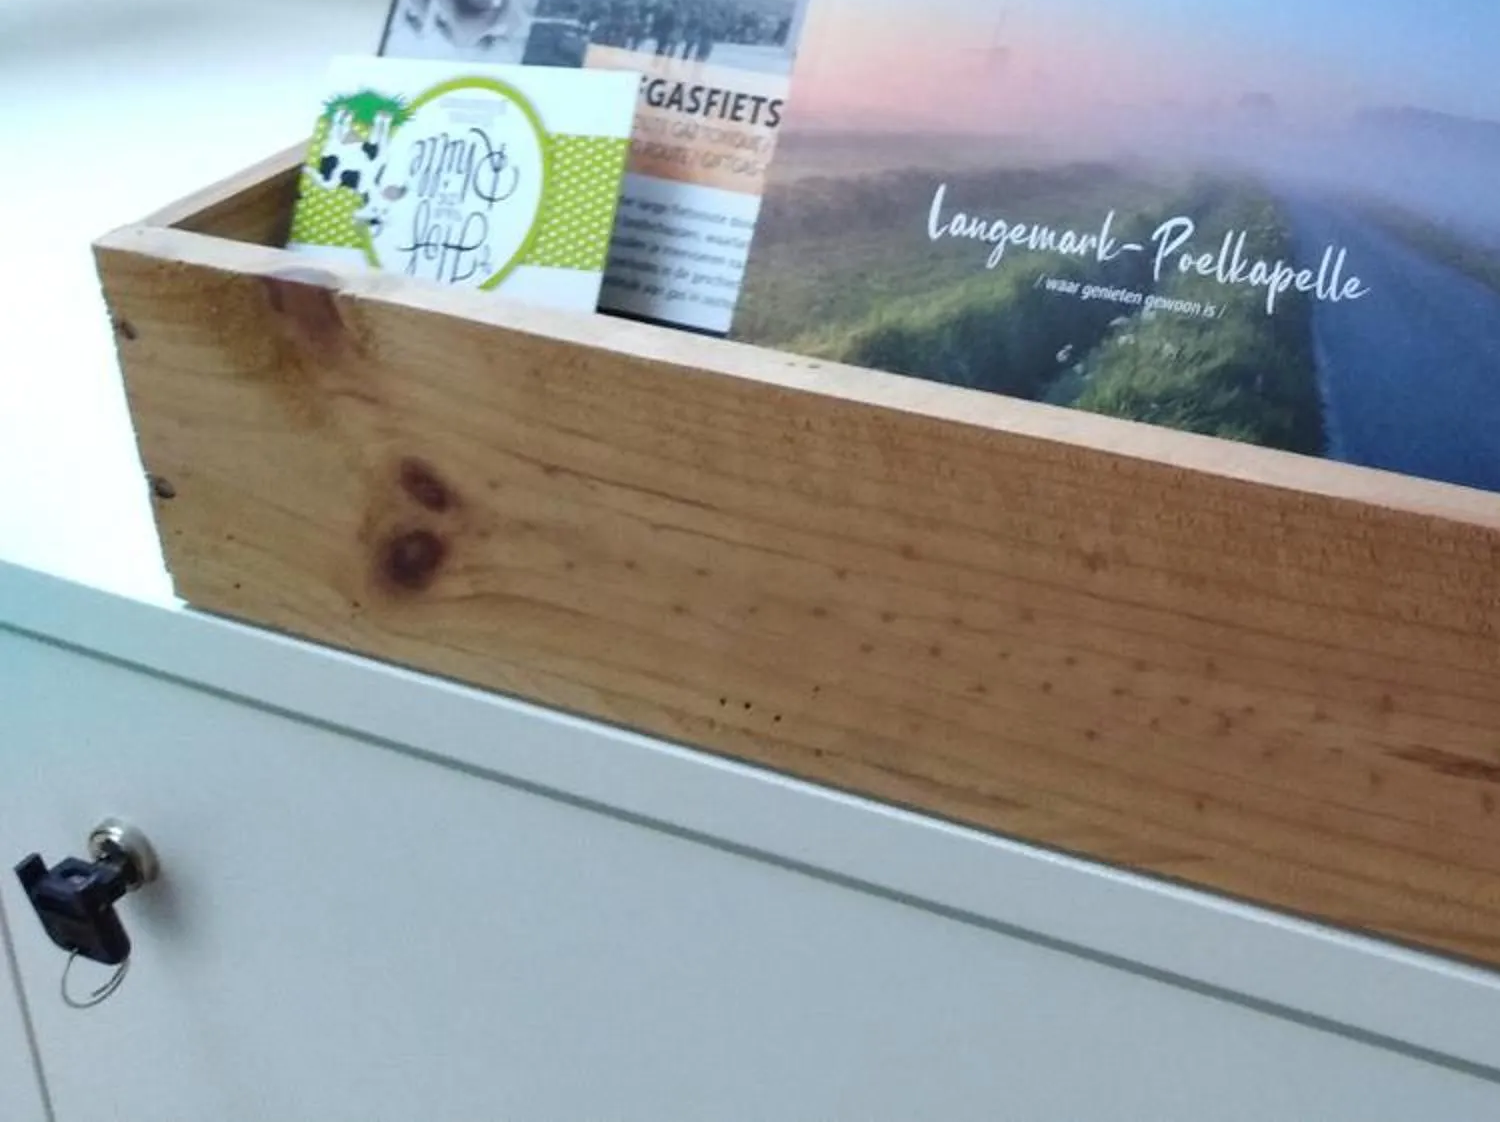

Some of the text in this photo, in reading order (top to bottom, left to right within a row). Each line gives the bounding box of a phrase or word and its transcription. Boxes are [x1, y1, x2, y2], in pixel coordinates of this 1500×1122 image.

[639, 75, 784, 128] GASFIETS
[926, 182, 1372, 315] Langemark-Poelkapelle
[1045, 277, 1081, 295] waar
[1081, 284, 1143, 305] genieten
[1143, 294, 1201, 316] gewoon
[1202, 301, 1217, 318] is
